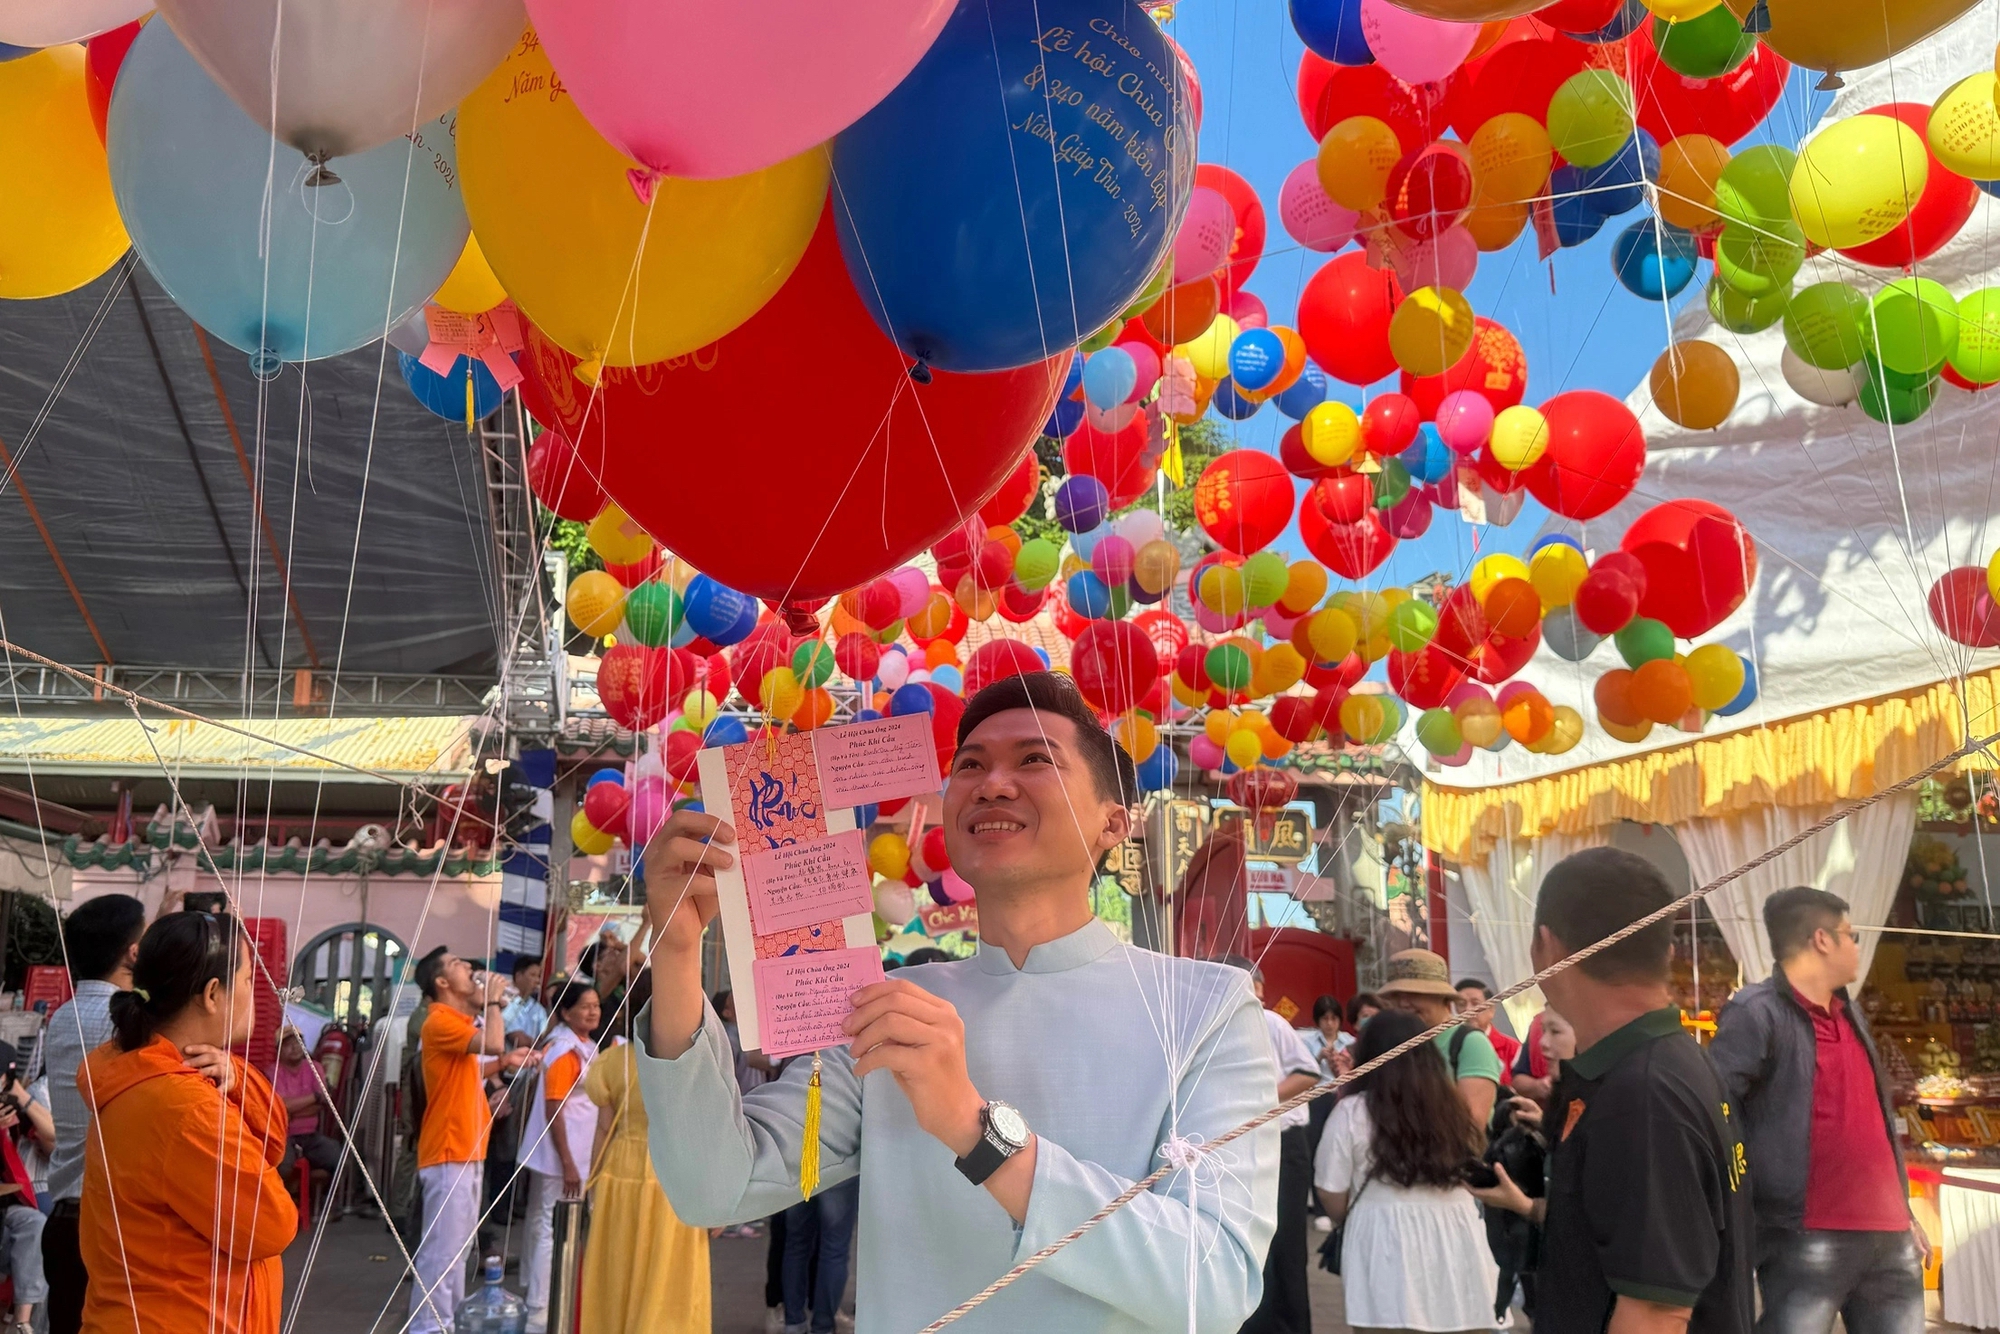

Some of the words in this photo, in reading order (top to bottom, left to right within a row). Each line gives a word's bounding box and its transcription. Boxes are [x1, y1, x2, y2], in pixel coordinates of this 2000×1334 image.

[518, 31, 540, 57] 34
[1089, 18, 1144, 60] Chào
[504, 70, 545, 103] Năm
[1031, 27, 1075, 53] Lễ
[1075, 41, 1115, 78] hội
[1118, 72, 1163, 128] Chùa
[1023, 64, 1044, 91] &
[1042, 79, 1083, 107] 340
[1086, 102, 1125, 141] năm
[433, 153, 456, 190] 2024
[1012, 111, 1058, 144] Năm
[1055, 133, 1093, 176] Giáp
[1094, 157, 1122, 199] Thìn
[1123, 204, 1143, 239] 2024
[849, 740, 866, 749] Phúc
[823, 842, 836, 850] 2024
[784, 860, 801, 870] Phúc
[795, 978, 813, 987] Phúc
